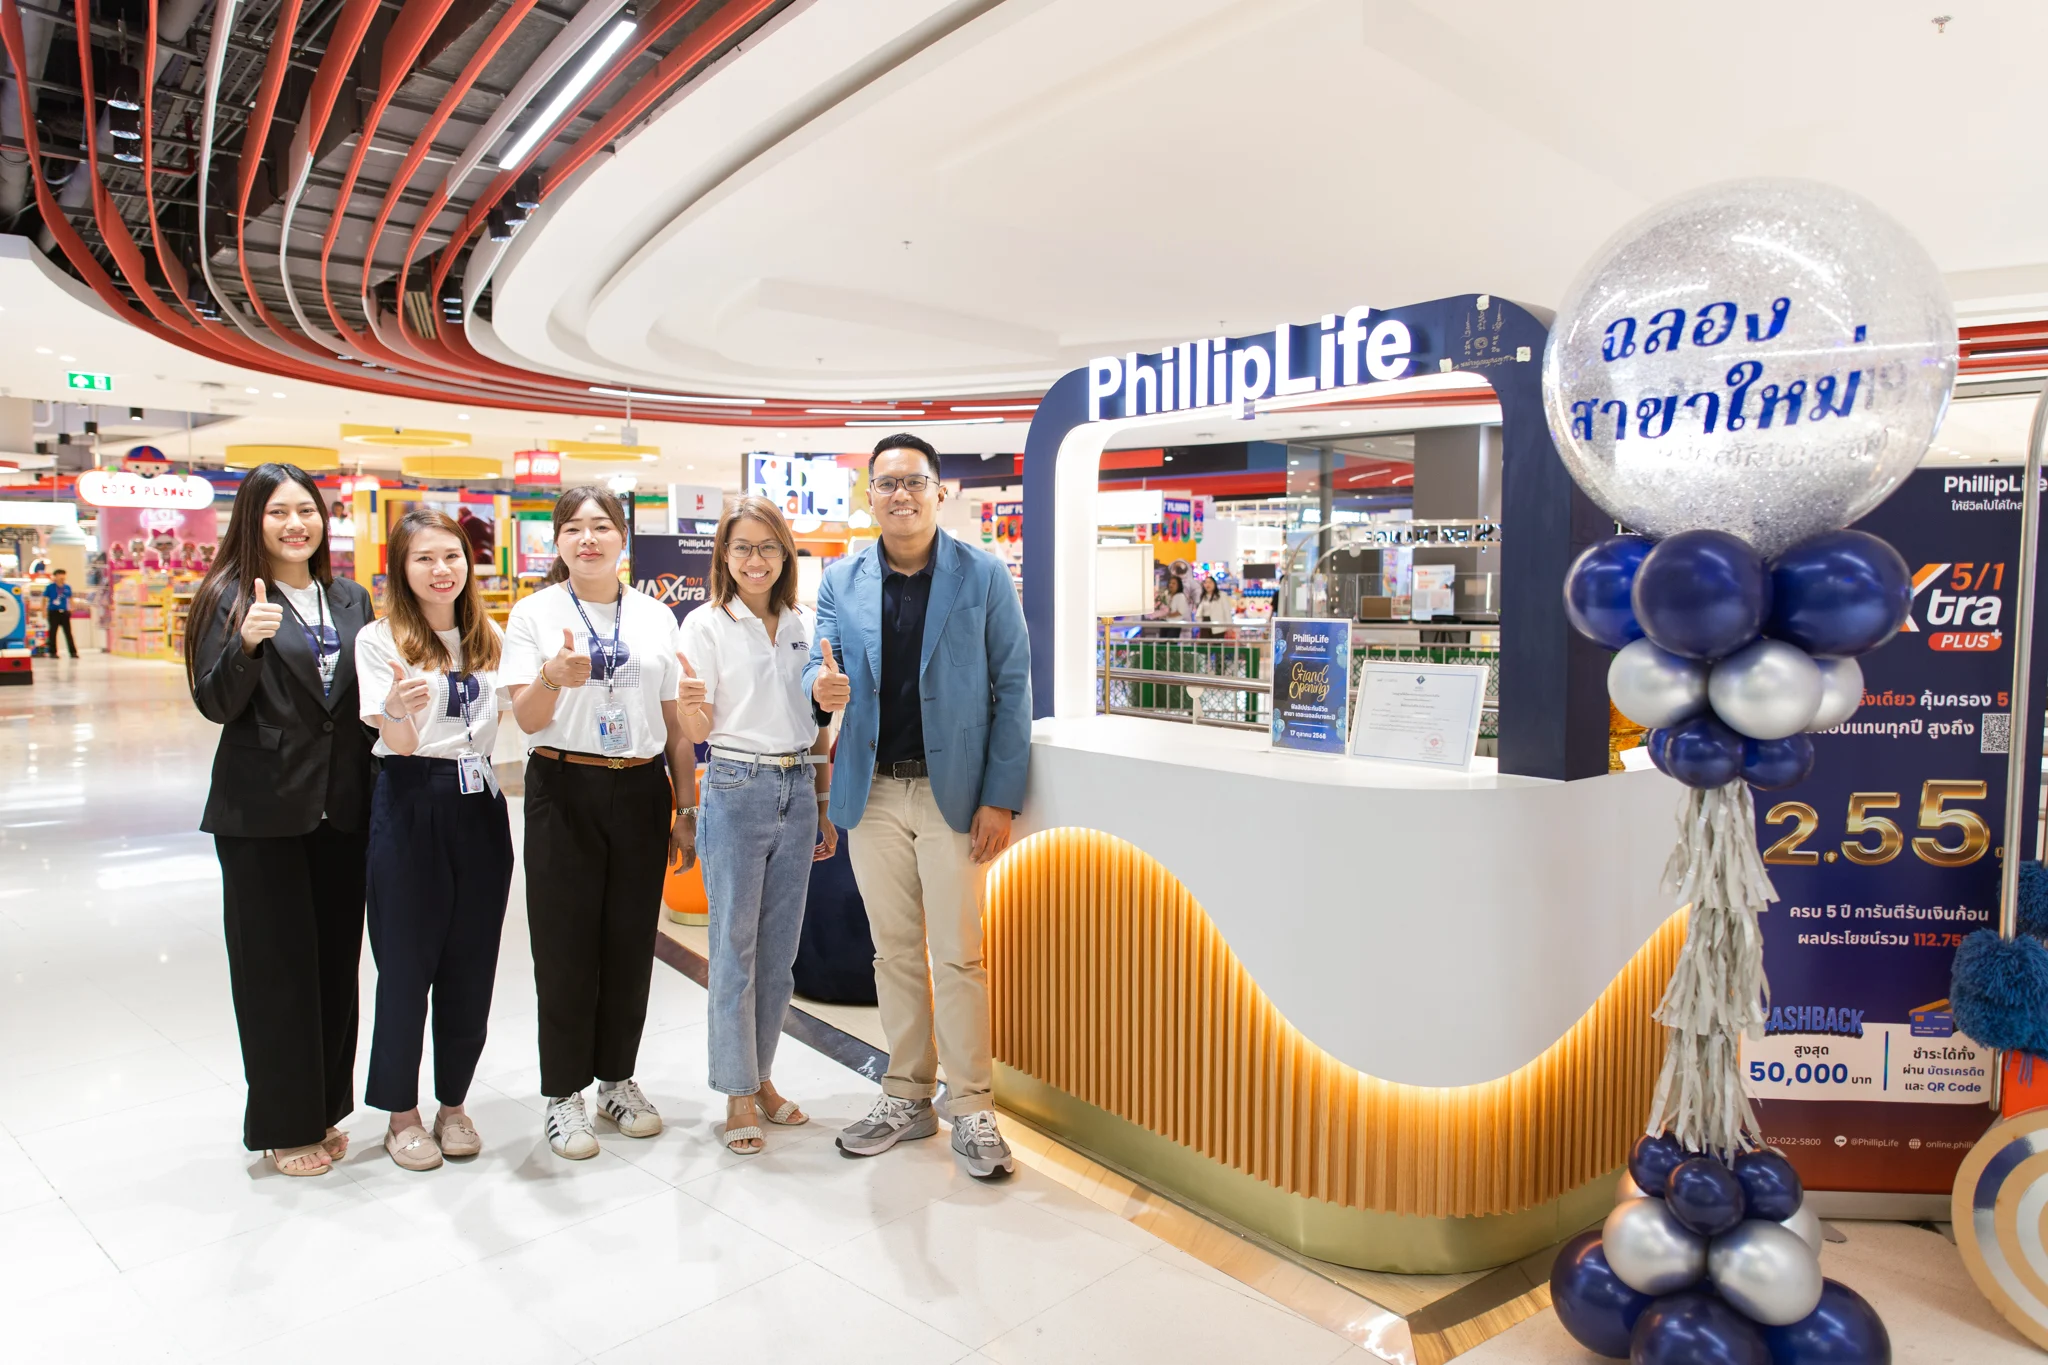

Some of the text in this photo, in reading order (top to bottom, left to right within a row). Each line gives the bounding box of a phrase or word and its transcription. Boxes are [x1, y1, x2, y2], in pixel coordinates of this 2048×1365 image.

[1602, 297, 1791, 362] ฉลอง
[1089, 305, 1412, 421] PhillipLife
[1570, 324, 1867, 440] สาขาใหม่
[1944, 475, 2048, 496] PhillipLe
[1951, 499, 2023, 511] ให้ชีวิตไปได้ไกล
[678, 539, 715, 548] PhillipLife
[686, 577, 703, 587] 10/1
[1951, 562, 2005, 591] 5/1
[1292, 633, 1330, 644] PhillipLife
[1292, 662, 1329, 683] Grand
[1289, 680, 1330, 702] Opening
[1859, 688, 2009, 711] รั้งเดียว คุ้มครอง 5
[1927, 718, 1975, 740] สูงถึง
[1789, 903, 1989, 921] ครบ 5 ปี การันตีรับเงินก้อน
[1797, 931, 1963, 947] ผลประโยชน์รวม 112.75
[1794, 1045, 1830, 1058] สูงสุด
[1913, 1047, 1976, 1061] ชำระได้ทั้ง
[1749, 1061, 1873, 1086] 50,000 บาท
[1903, 1064, 1985, 1077] ผ่าน บัตรเครดิต
[1905, 1081, 1982, 1093] และ QR Code
[1766, 1136, 1821, 1146] 02-022-5800
[1850, 1137, 1899, 1148] @PhillipLife
